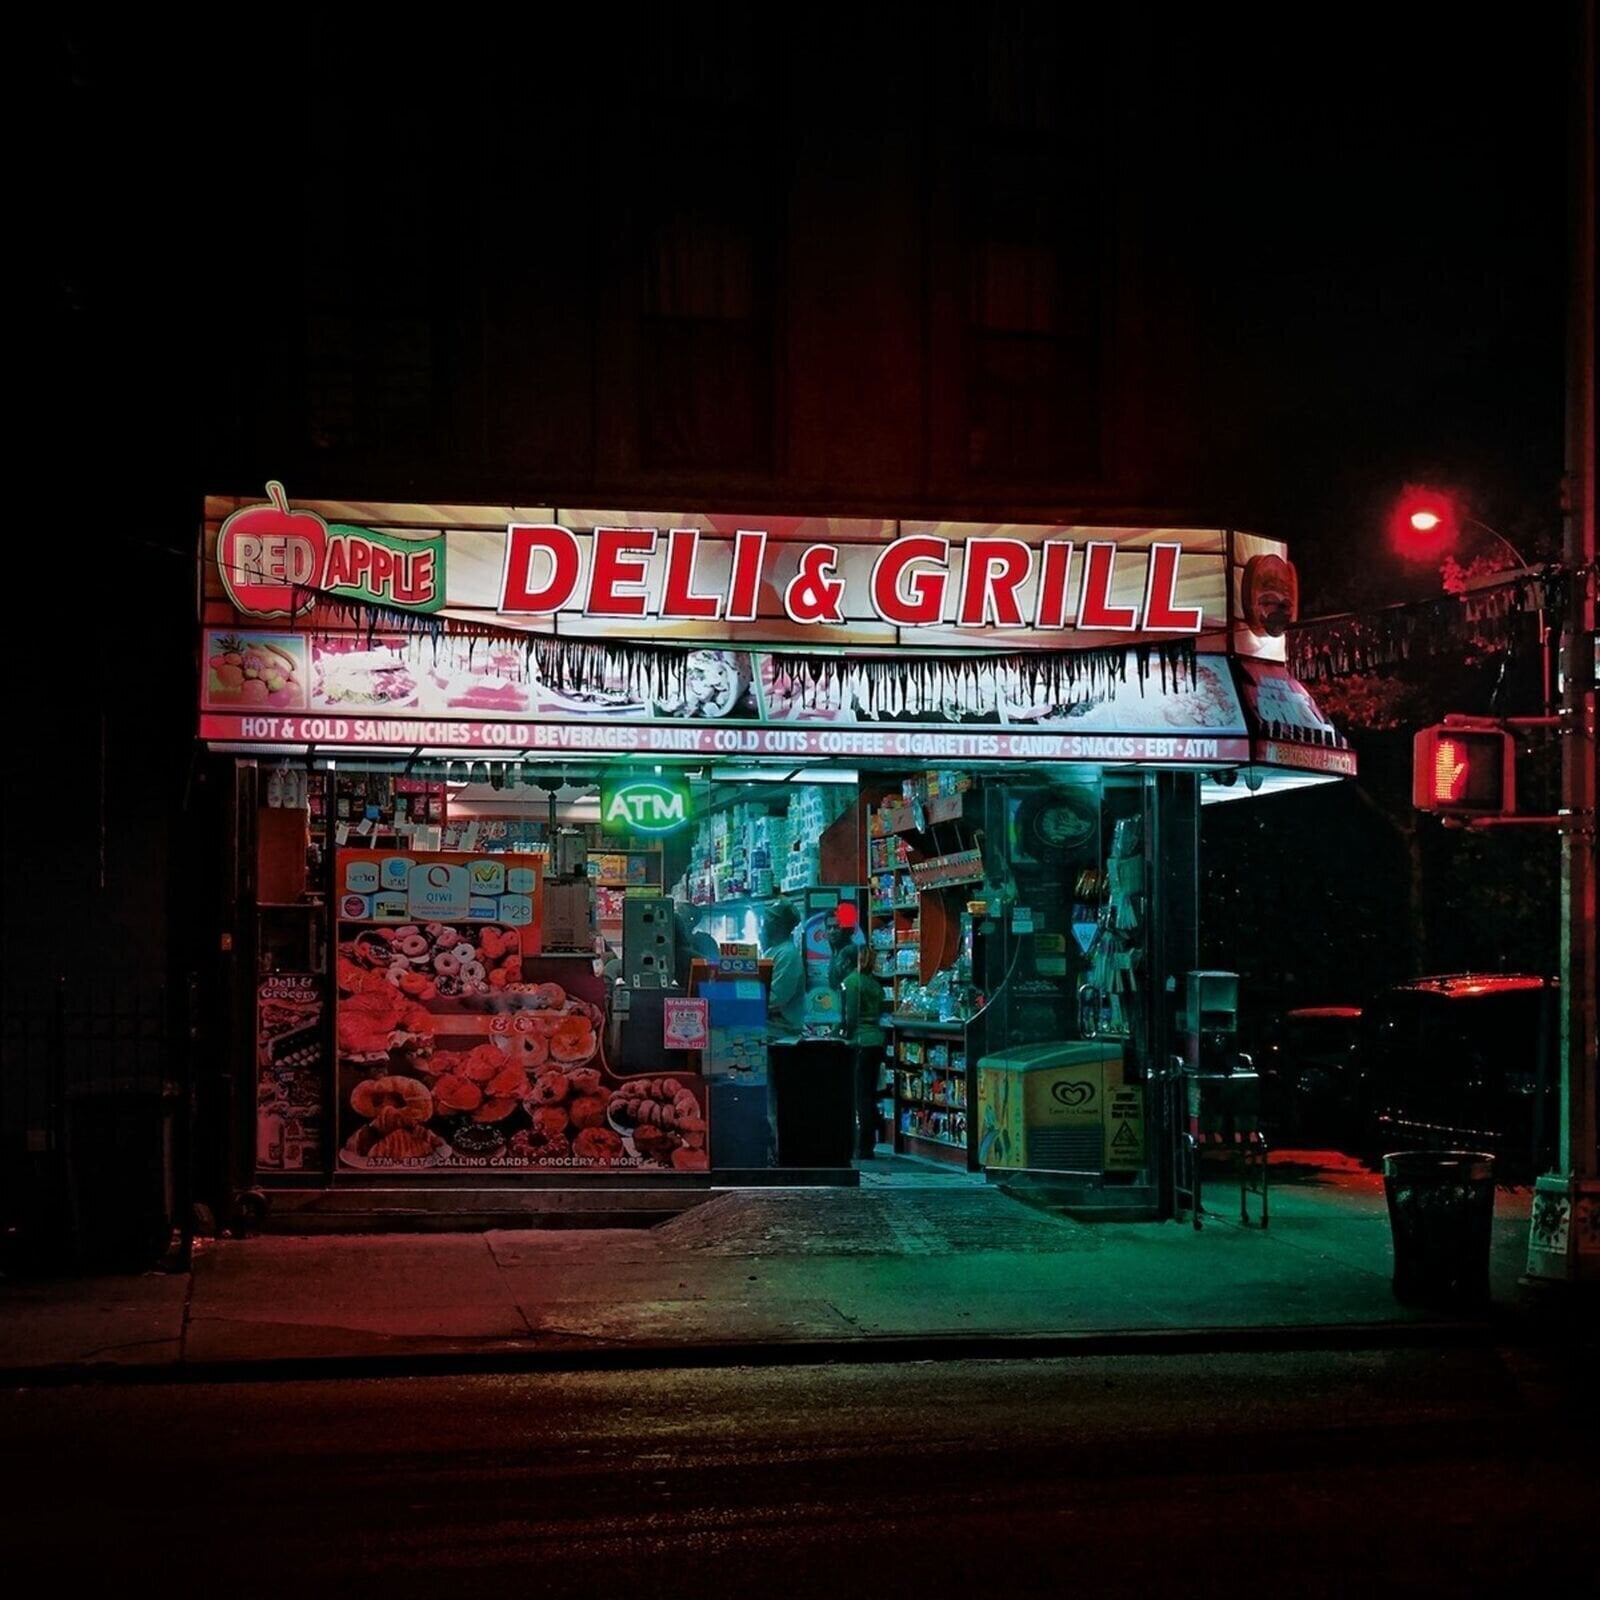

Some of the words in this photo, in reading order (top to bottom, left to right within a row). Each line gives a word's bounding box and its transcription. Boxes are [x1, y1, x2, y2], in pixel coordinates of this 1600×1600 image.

[234, 534, 314, 587] RED
[323, 534, 436, 604] APPLE
[497, 523, 767, 621] DELI
[785, 544, 846, 624] &
[871, 535, 1203, 631] GRILL
[241, 717, 278, 737] HOT
[281, 720, 294, 738] &
[300, 719, 348, 739] COLD
[354, 720, 470, 743] SANDWICHES
[481, 724, 528, 744] COLD
[534, 725, 638, 747] BEVERAGES
[652, 729, 702, 749] DAIRY
[714, 730, 758, 750] COLD
[765, 731, 807, 751] CUTS
[819, 732, 885, 753] COFFEE
[895, 733, 999, 755] CIGARETTES
[1009, 735, 1064, 756] CANDY
[1071, 737, 1134, 757] SNACKS
[1145, 739, 1175, 757] EBT
[1184, 739, 1218, 758] ATM
[606, 794, 686, 821] ATM
[426, 892, 453, 904] QIWI
[268, 977, 296, 988] Deli
[261, 988, 319, 1000] Grocery
[437, 1157, 487, 1167] CALLING
[490, 1157, 529, 1167] CARDS
[539, 1157, 594, 1167] GROCERY
